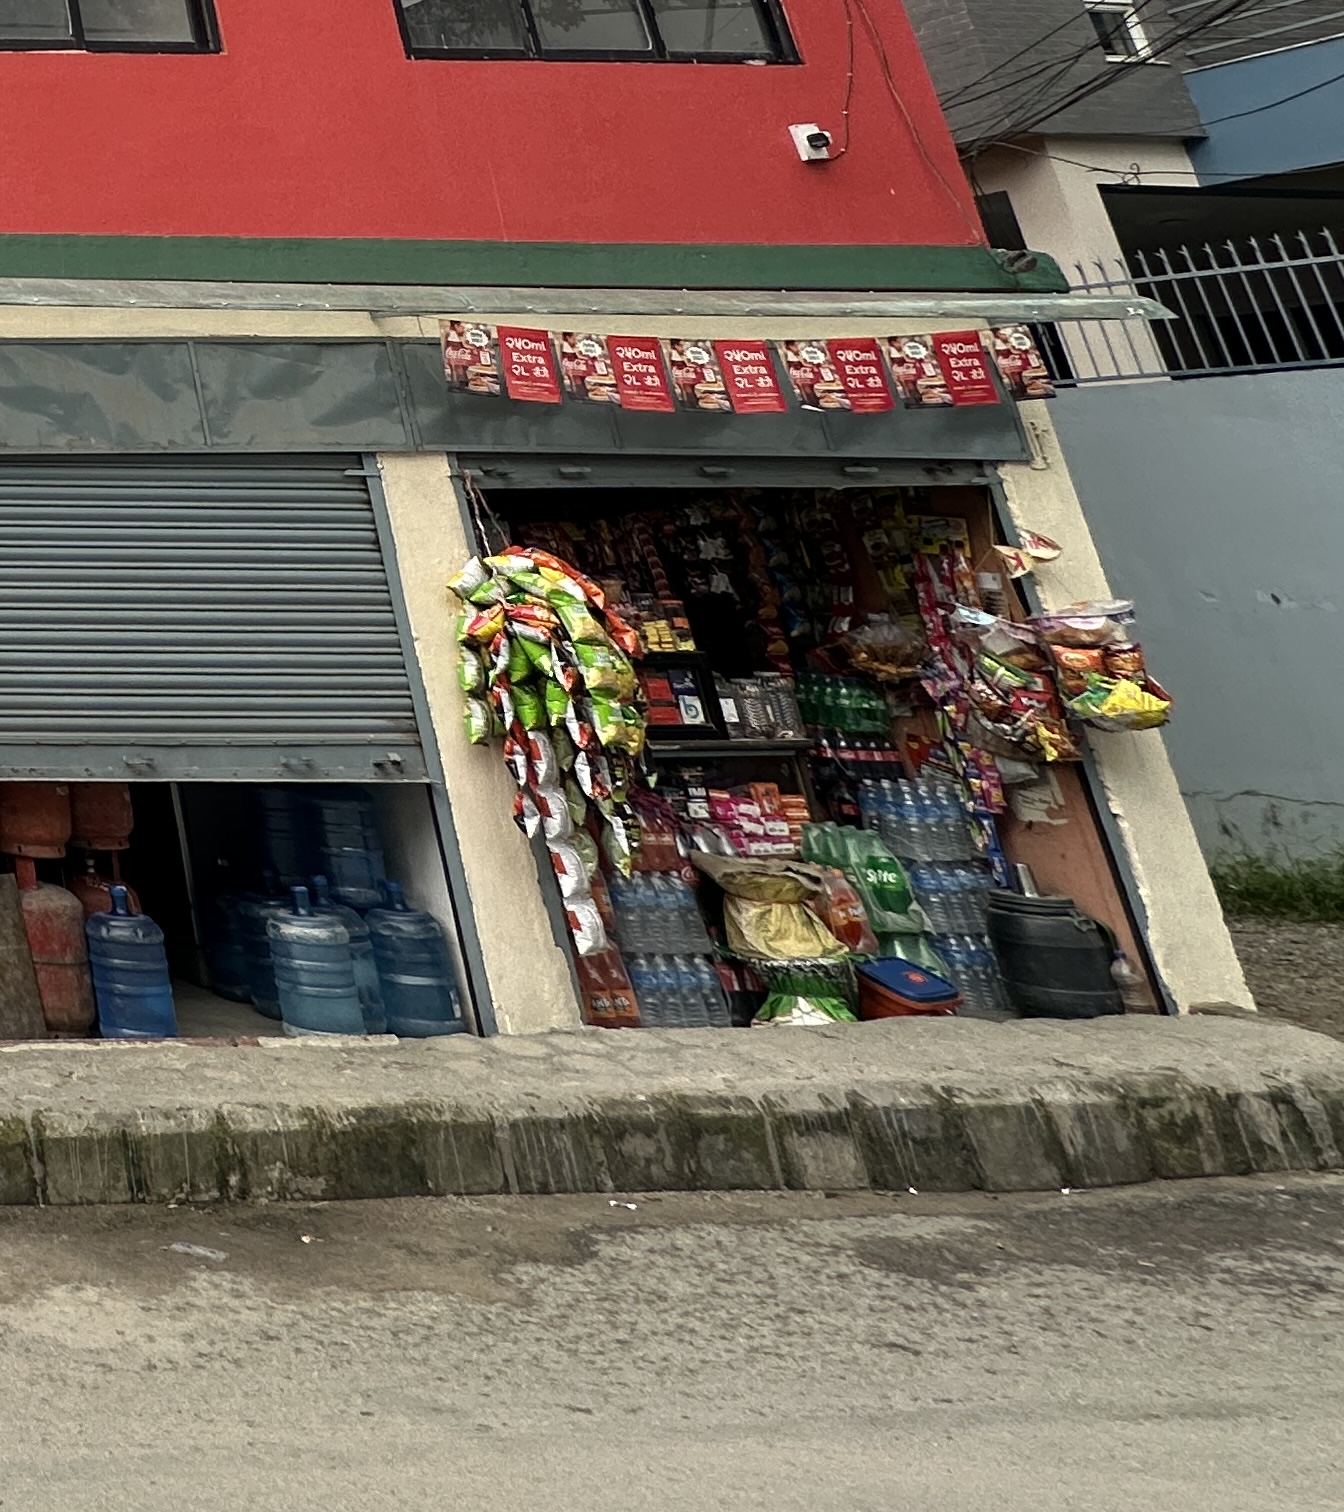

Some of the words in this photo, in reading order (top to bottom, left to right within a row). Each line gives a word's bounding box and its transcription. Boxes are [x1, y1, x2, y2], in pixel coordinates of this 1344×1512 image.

[511, 352, 545, 365] Extra
[949, 357, 981, 368] Extra
[622, 361, 656, 373] Extra
[732, 364, 767, 375] Extra
[845, 364, 878, 375] Extra
